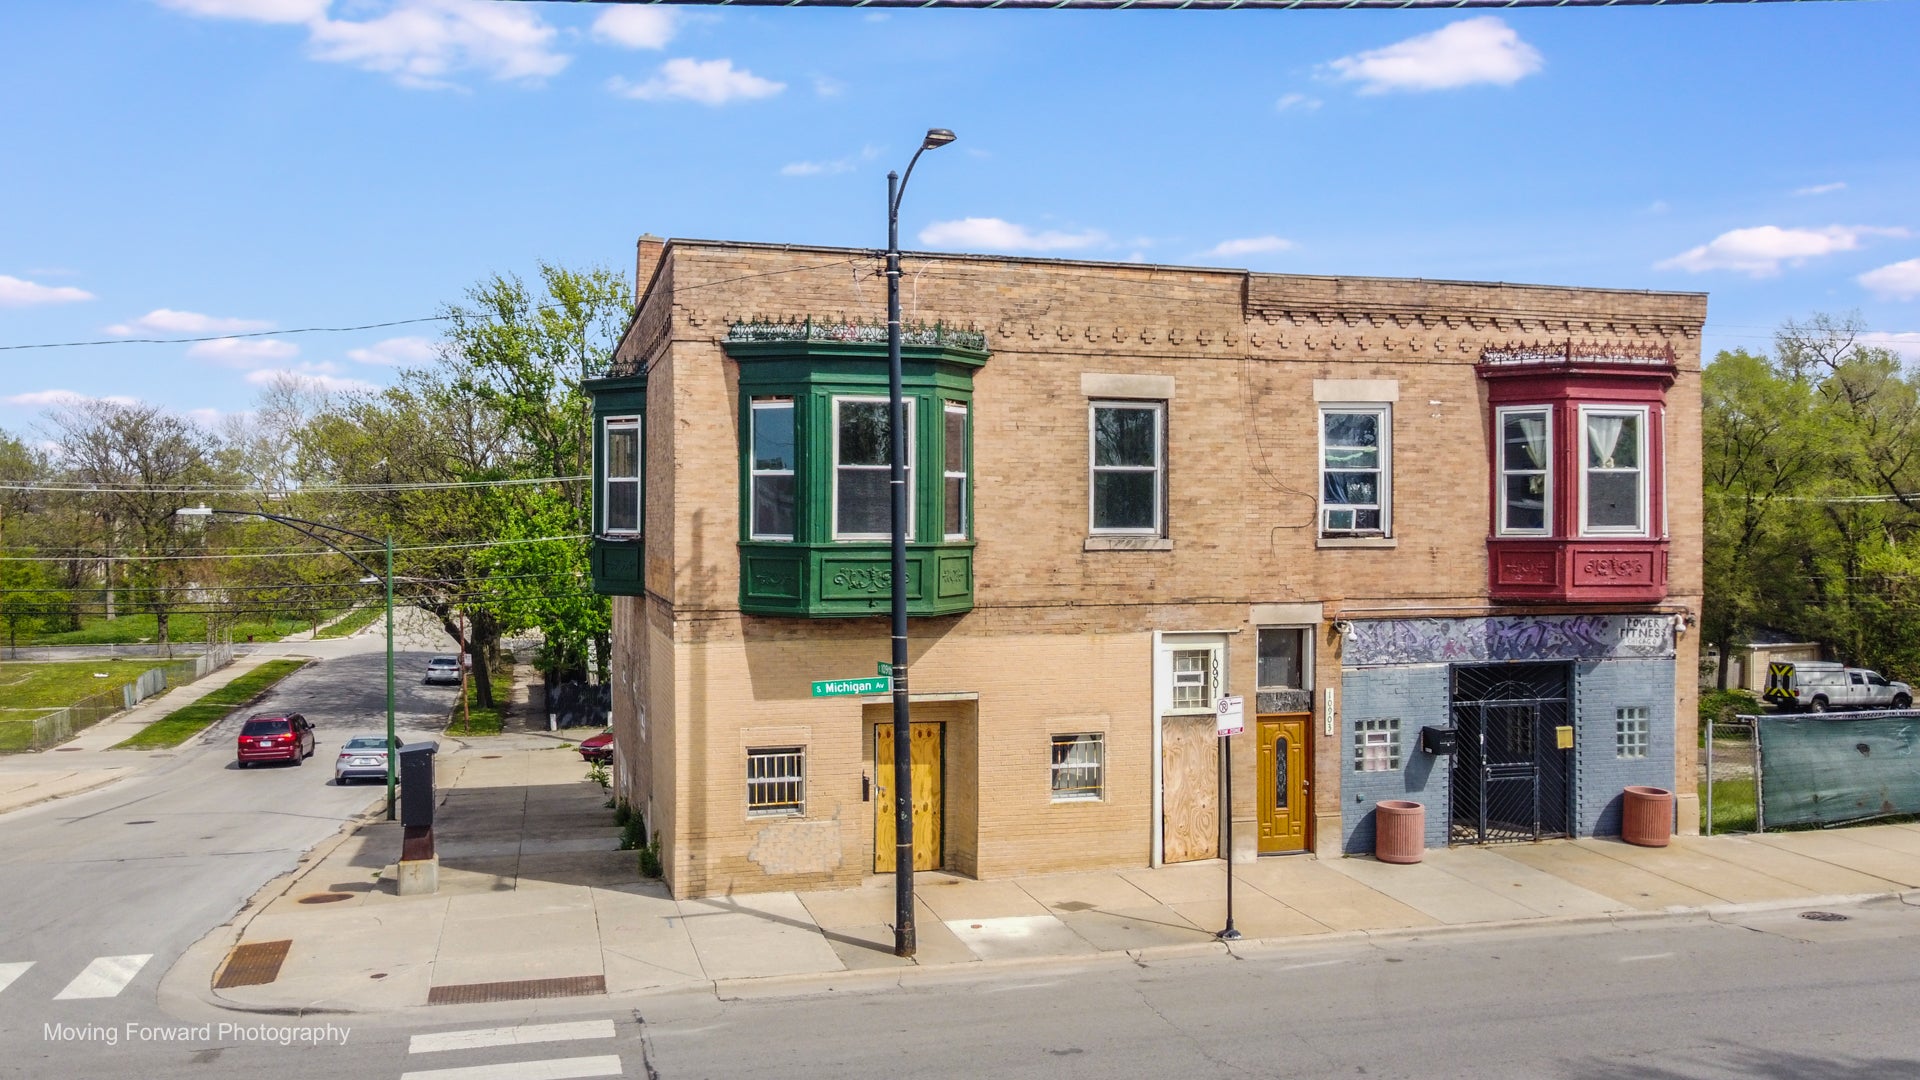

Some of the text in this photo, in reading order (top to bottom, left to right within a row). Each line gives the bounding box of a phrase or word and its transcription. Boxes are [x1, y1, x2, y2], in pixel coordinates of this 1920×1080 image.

[1627, 617, 1660, 628] POWER
[1620, 628, 1667, 638] FITNESS
[816, 685, 822, 693] S
[825, 681, 872, 694] Michigan
